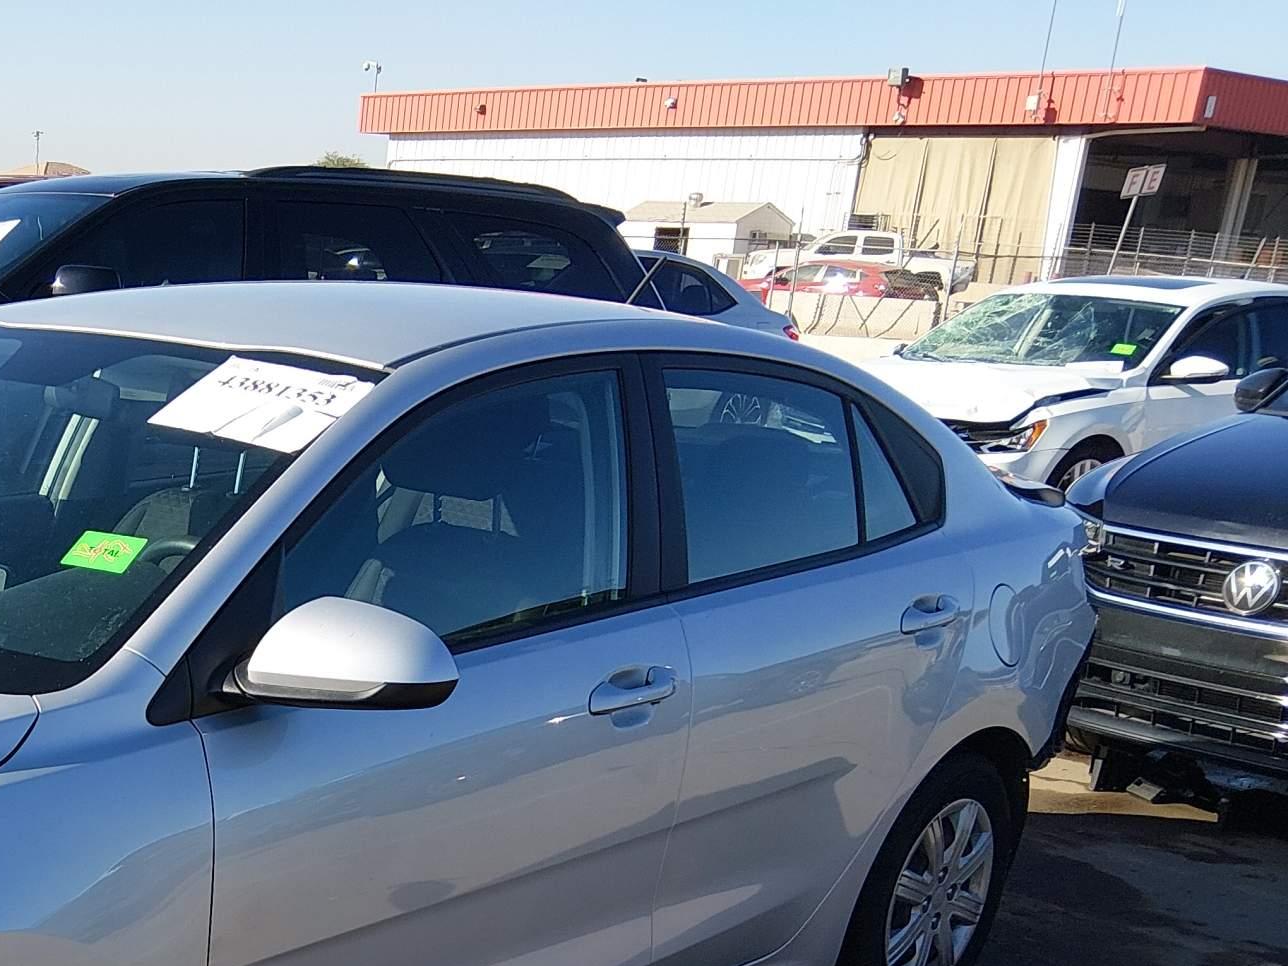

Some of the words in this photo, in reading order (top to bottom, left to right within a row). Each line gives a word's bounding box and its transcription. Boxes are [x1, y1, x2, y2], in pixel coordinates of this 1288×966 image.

[1127, 173, 1141, 194] F
[1147, 170, 1161, 191] E
[218, 375, 337, 406] 43881353
